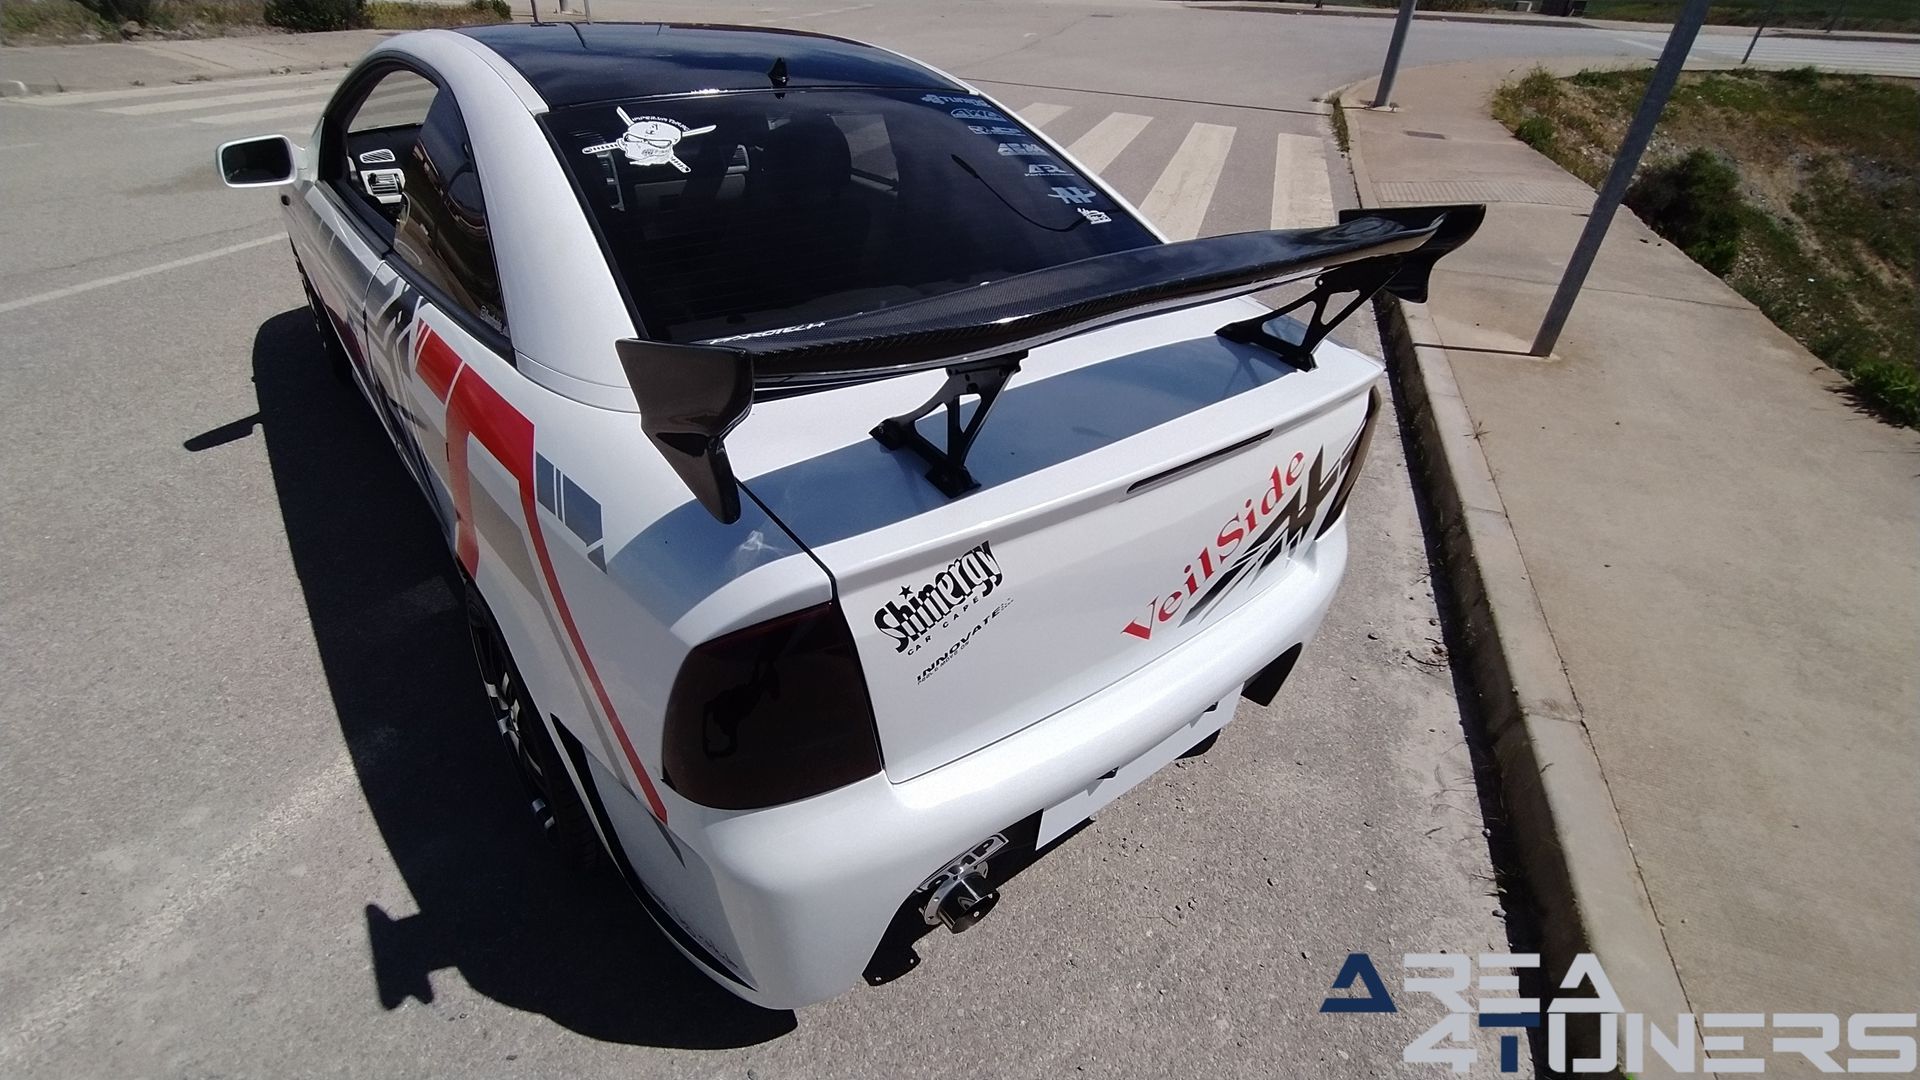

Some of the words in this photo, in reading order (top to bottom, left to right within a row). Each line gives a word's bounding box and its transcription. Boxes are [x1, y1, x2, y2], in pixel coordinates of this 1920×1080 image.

[874, 540, 1003, 653] Shinergy
[1120, 451, 1305, 640] VeilSide
[917, 606, 1001, 681] INNOVATE
